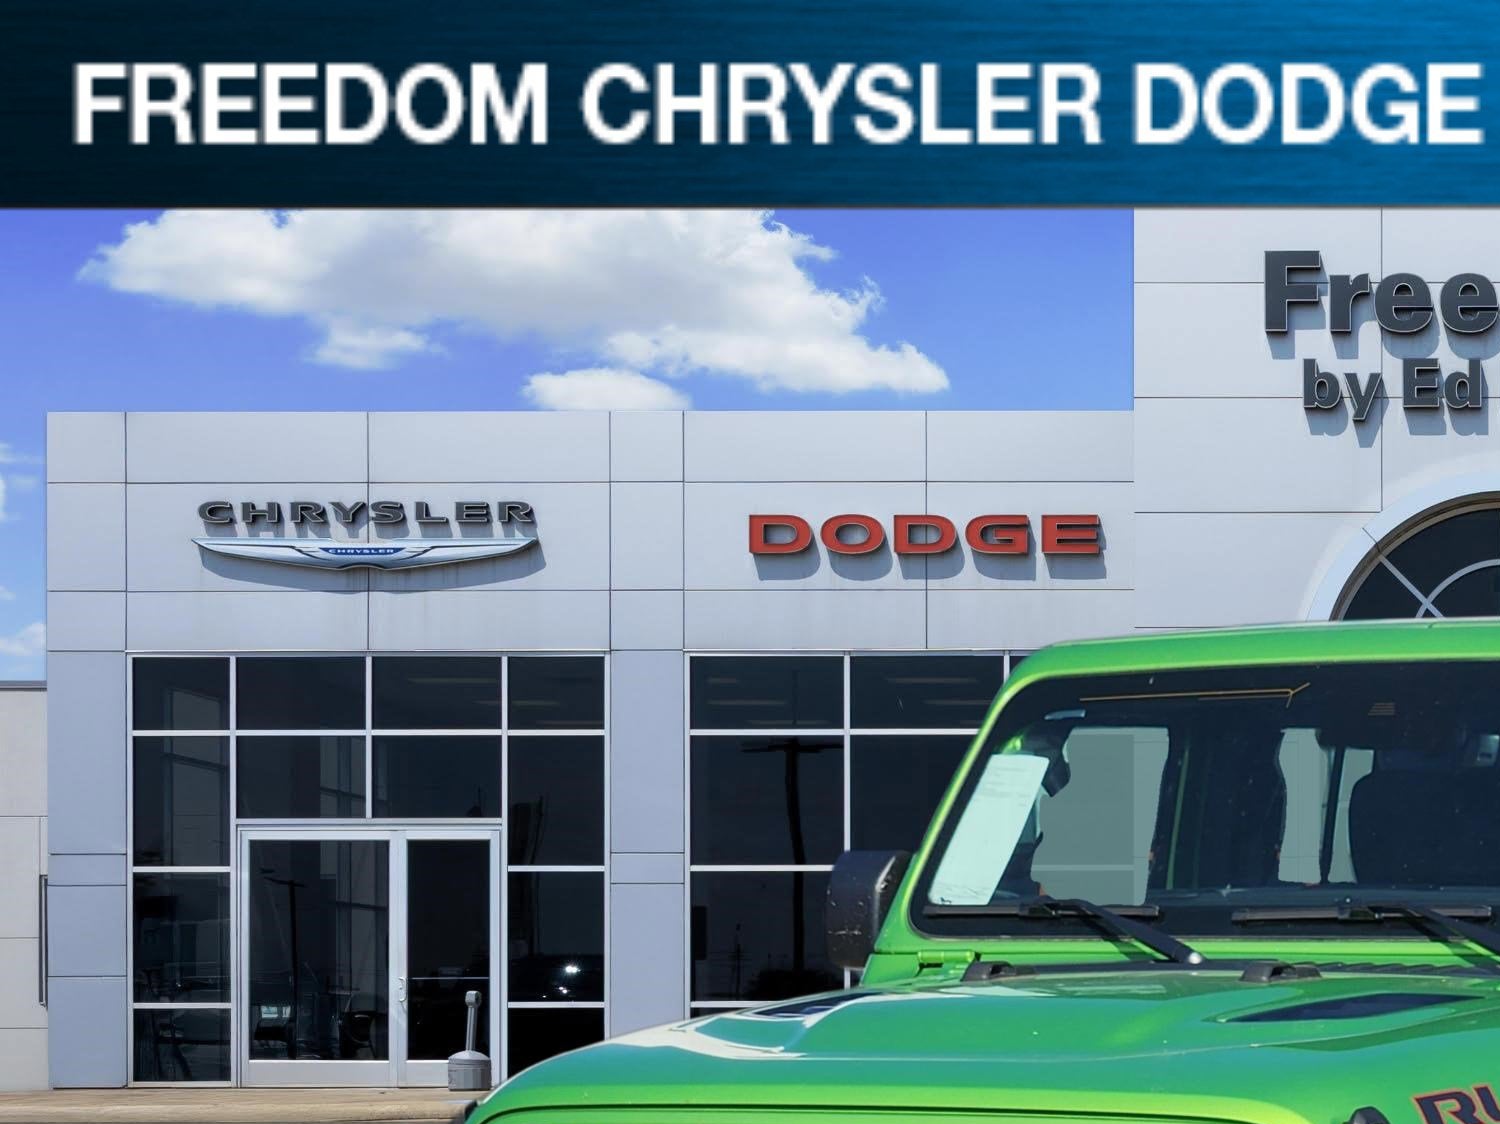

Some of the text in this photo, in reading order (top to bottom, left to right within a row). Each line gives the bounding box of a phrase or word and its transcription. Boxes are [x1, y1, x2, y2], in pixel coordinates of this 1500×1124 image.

[1303, 358, 1382, 421] by
[1402, 358, 1482, 408] Ed
[197, 500, 536, 524] CHRYSLER
[749, 513, 1101, 555] DODGE
